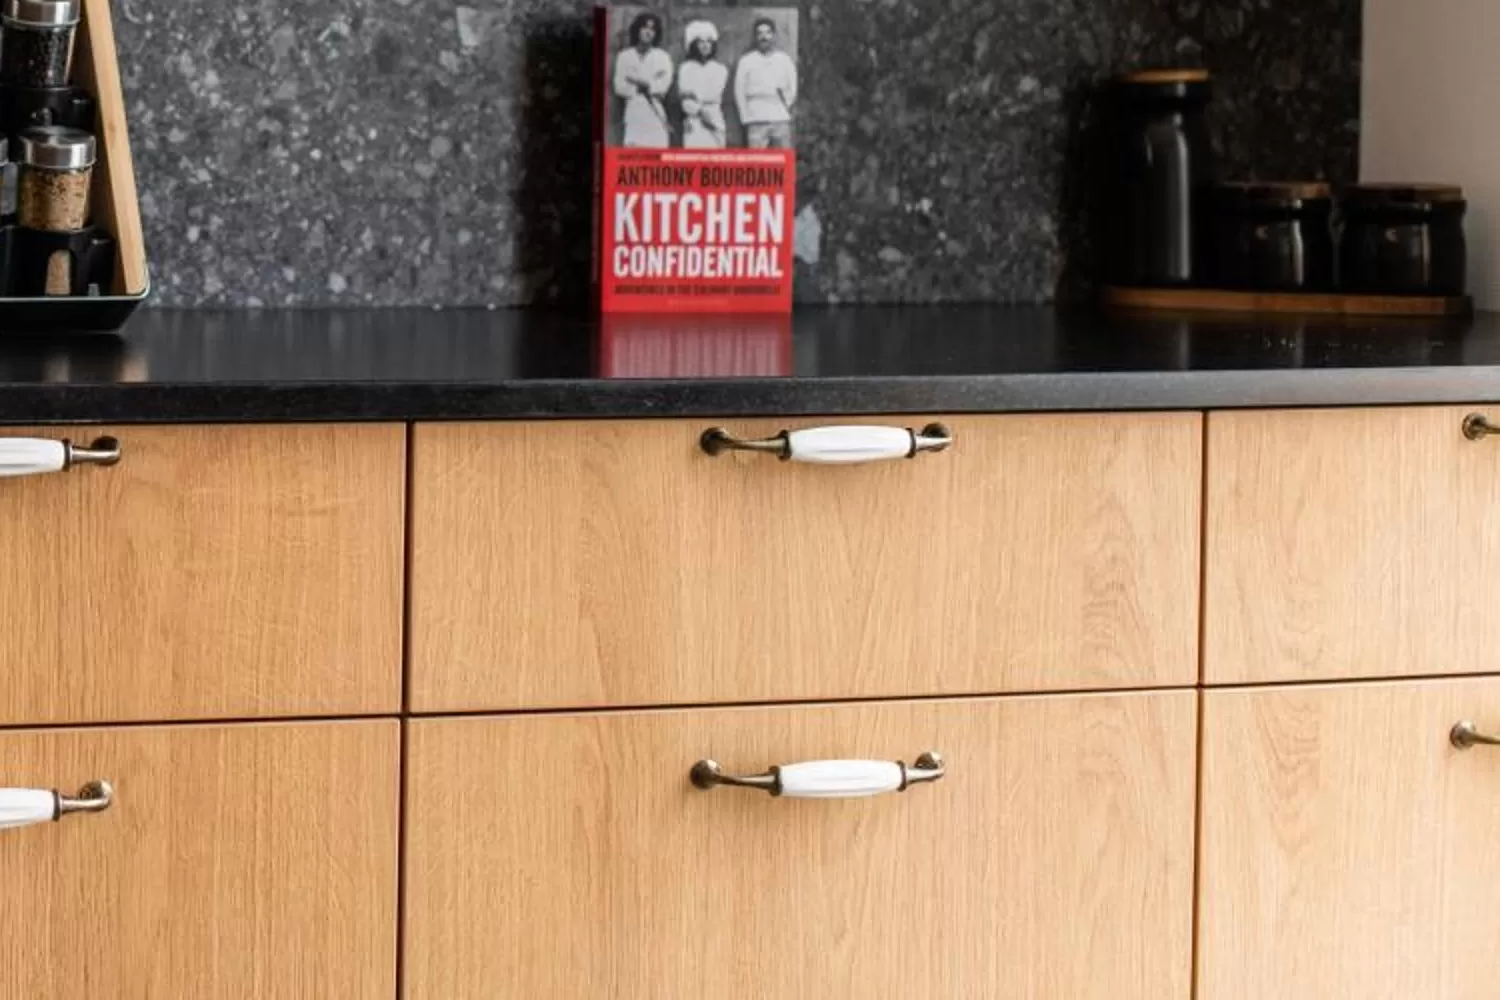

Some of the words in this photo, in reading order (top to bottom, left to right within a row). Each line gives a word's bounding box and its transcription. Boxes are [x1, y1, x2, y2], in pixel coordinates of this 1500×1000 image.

[617, 165, 695, 187] ANTHONY
[701, 166, 785, 188] BOURDAIN
[614, 191, 785, 244] KITCHEN
[613, 245, 784, 278] CONFIDENTIAL
